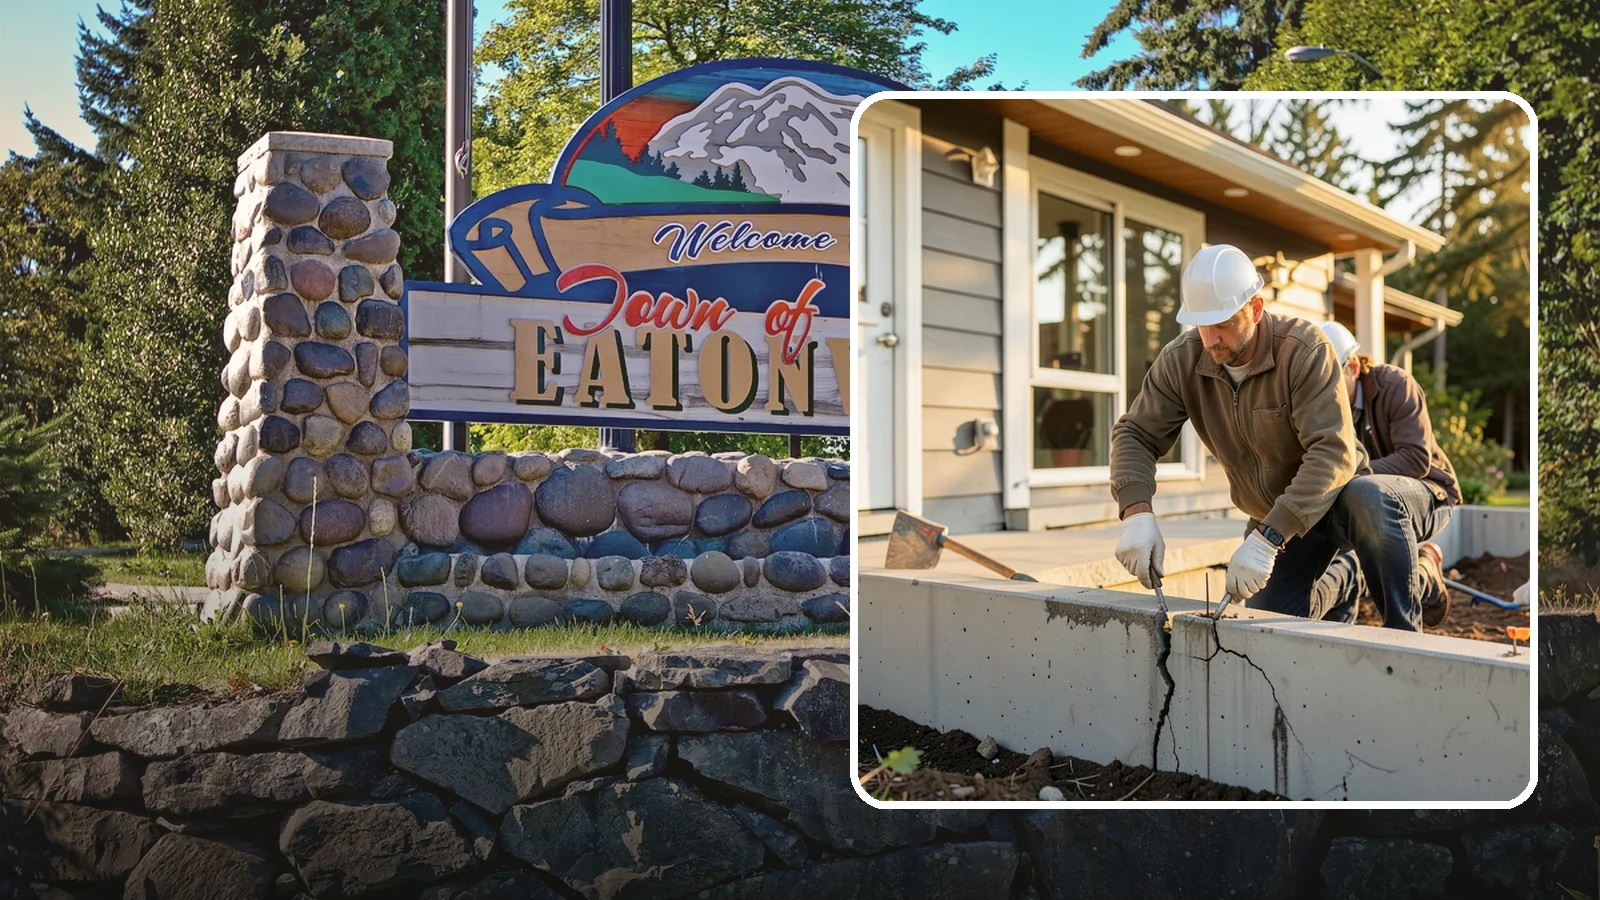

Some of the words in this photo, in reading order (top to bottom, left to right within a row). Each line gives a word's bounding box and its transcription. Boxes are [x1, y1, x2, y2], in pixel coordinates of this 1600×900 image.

[653, 220, 837, 263] Welcome
[556, 263, 737, 336] Town
[764, 278, 826, 366] of
